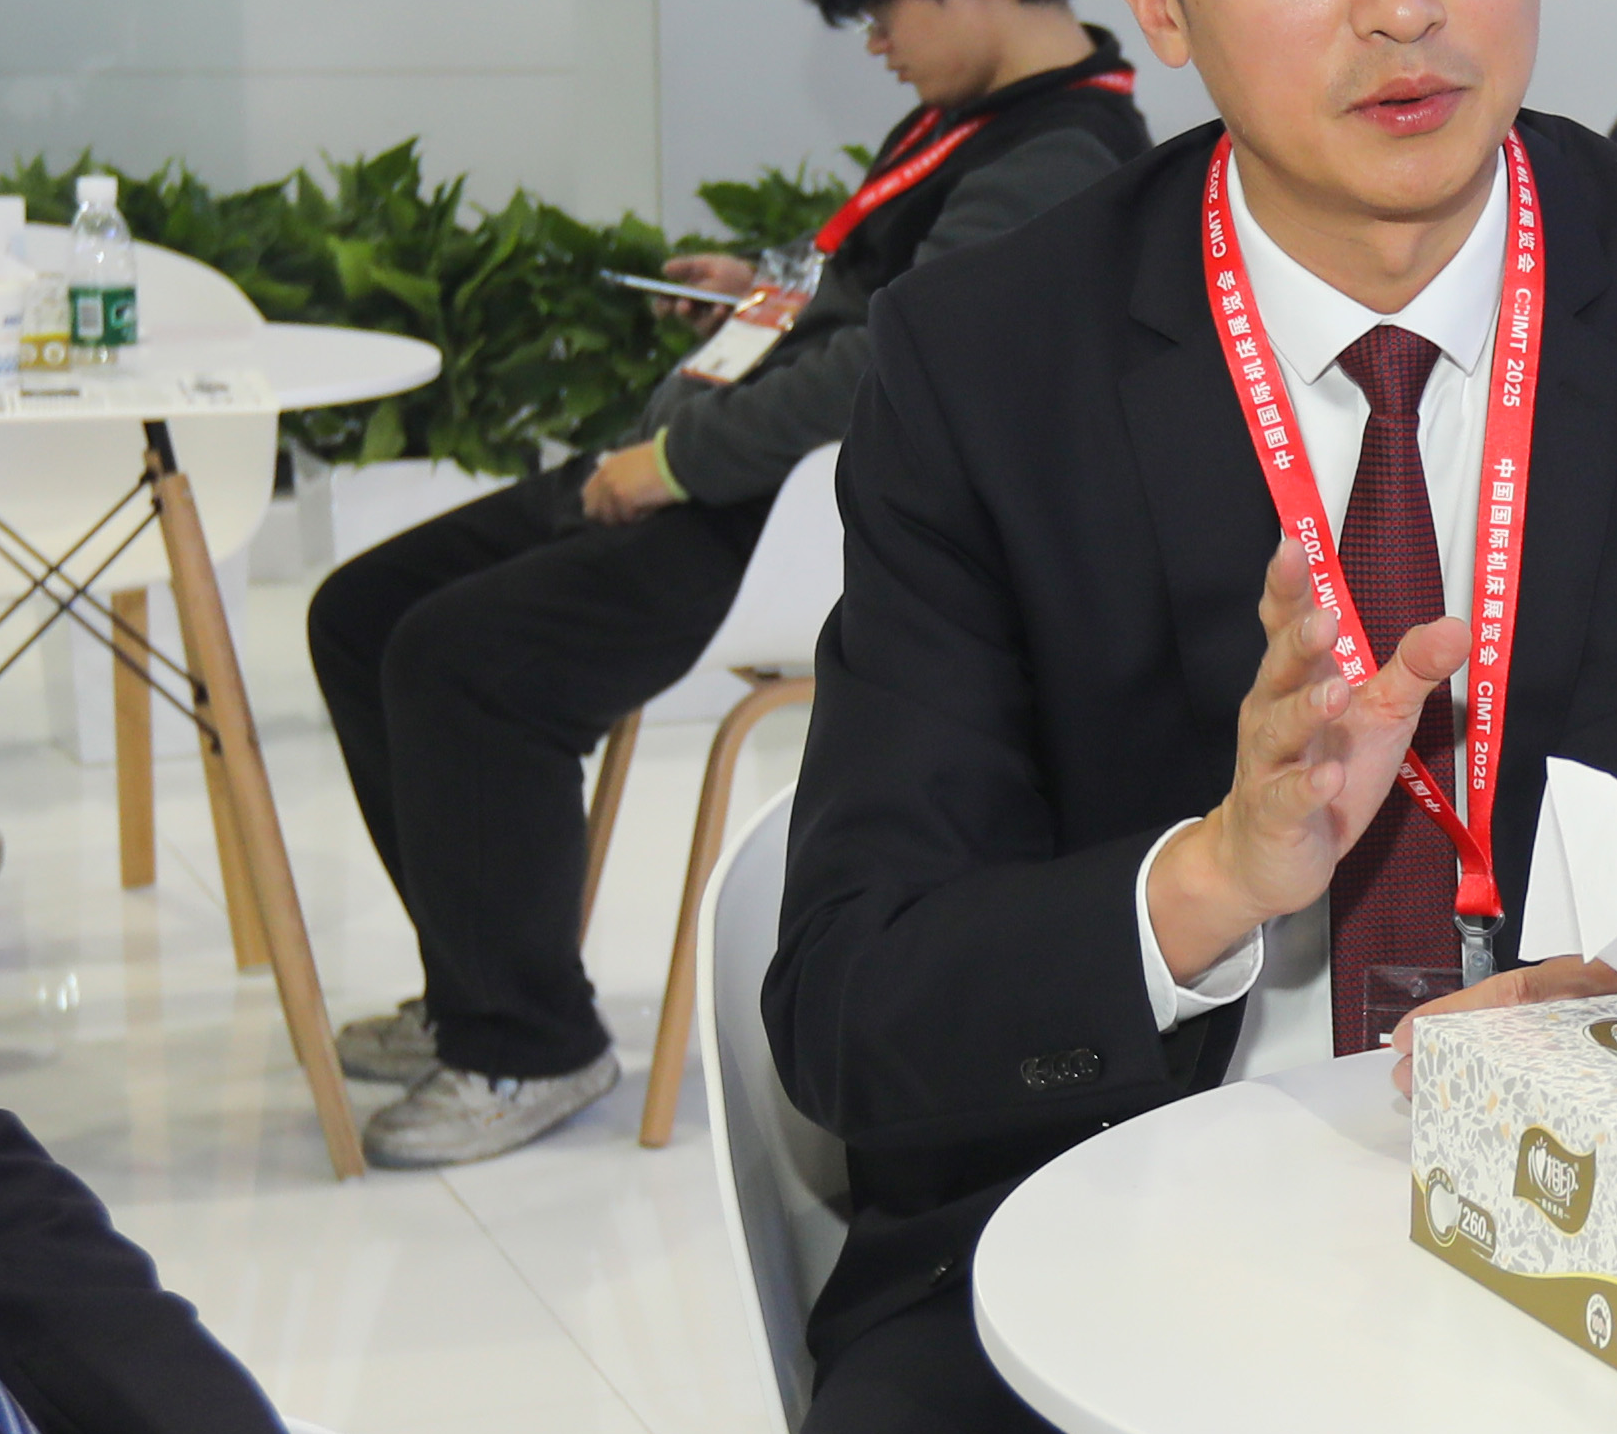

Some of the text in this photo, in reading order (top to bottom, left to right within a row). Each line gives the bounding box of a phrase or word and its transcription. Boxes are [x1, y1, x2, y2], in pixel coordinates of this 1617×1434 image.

[1211, 208, 1228, 258] CIMT
[1216, 270, 1295, 470] 中国国际机床展览会
[1503, 360, 1525, 407] 2025
[1296, 517, 1326, 565] 2025
[1472, 458, 1516, 790] 中国国际机床展览会 CIMT 2025
[1334, 635, 1368, 686] 览会
